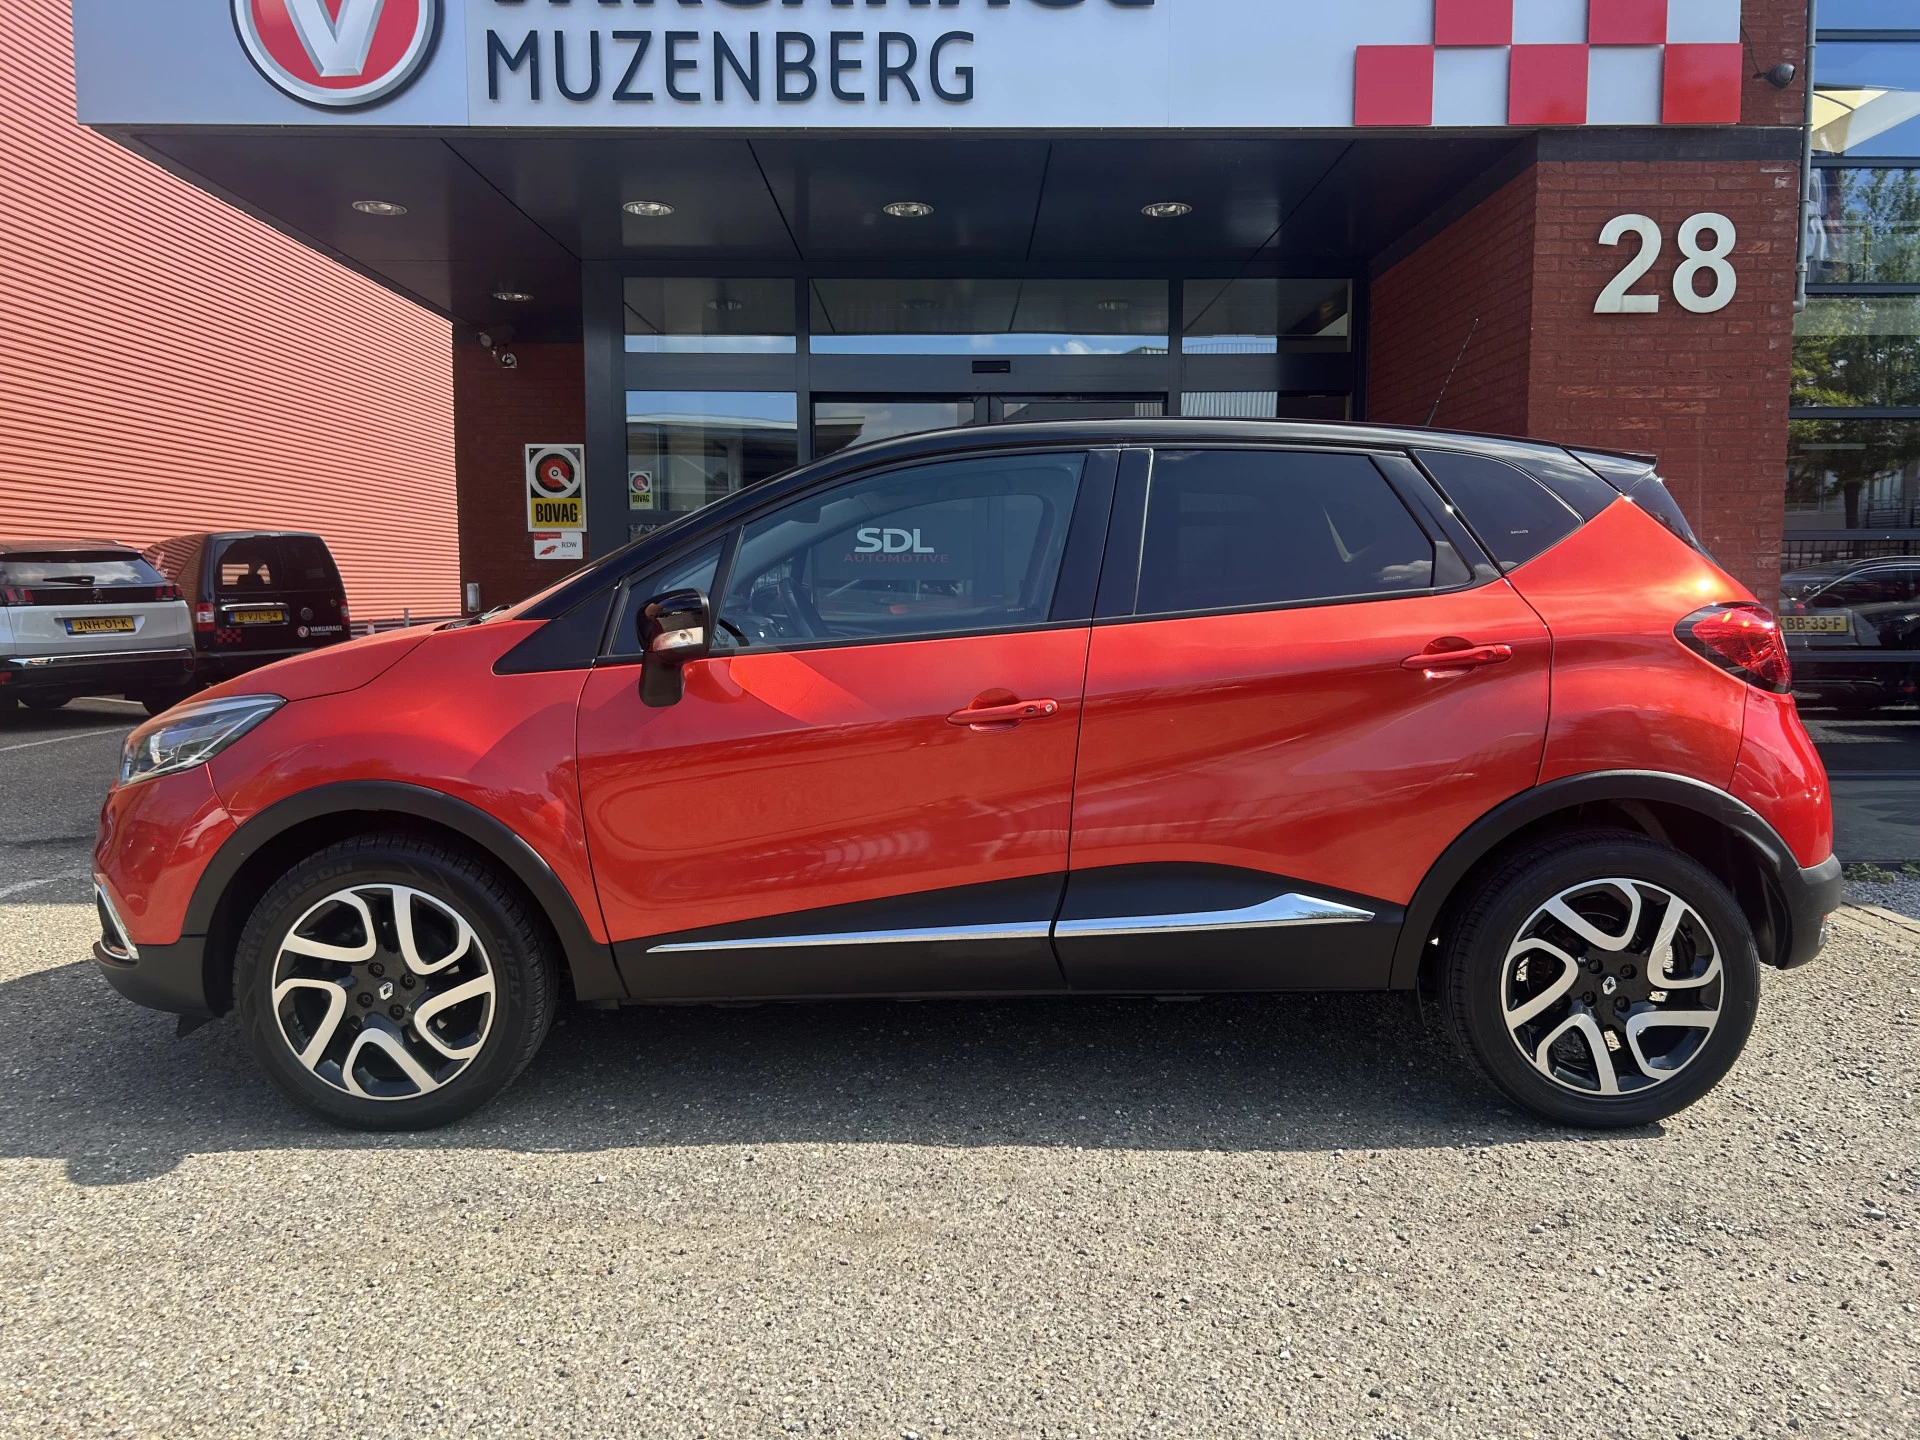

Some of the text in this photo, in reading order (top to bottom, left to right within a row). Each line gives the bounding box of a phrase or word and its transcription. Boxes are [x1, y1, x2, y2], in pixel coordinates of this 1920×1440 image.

[486, 29, 974, 102] MUZENBERG
[1593, 212, 1737, 314] 28
[632, 494, 650, 503] BOVAG
[535, 503, 578, 523] BOVAG
[854, 527, 935, 553] SDL
[843, 553, 950, 563] AUTOMOTIVE
[77, 618, 129, 630] JNH-01-K
